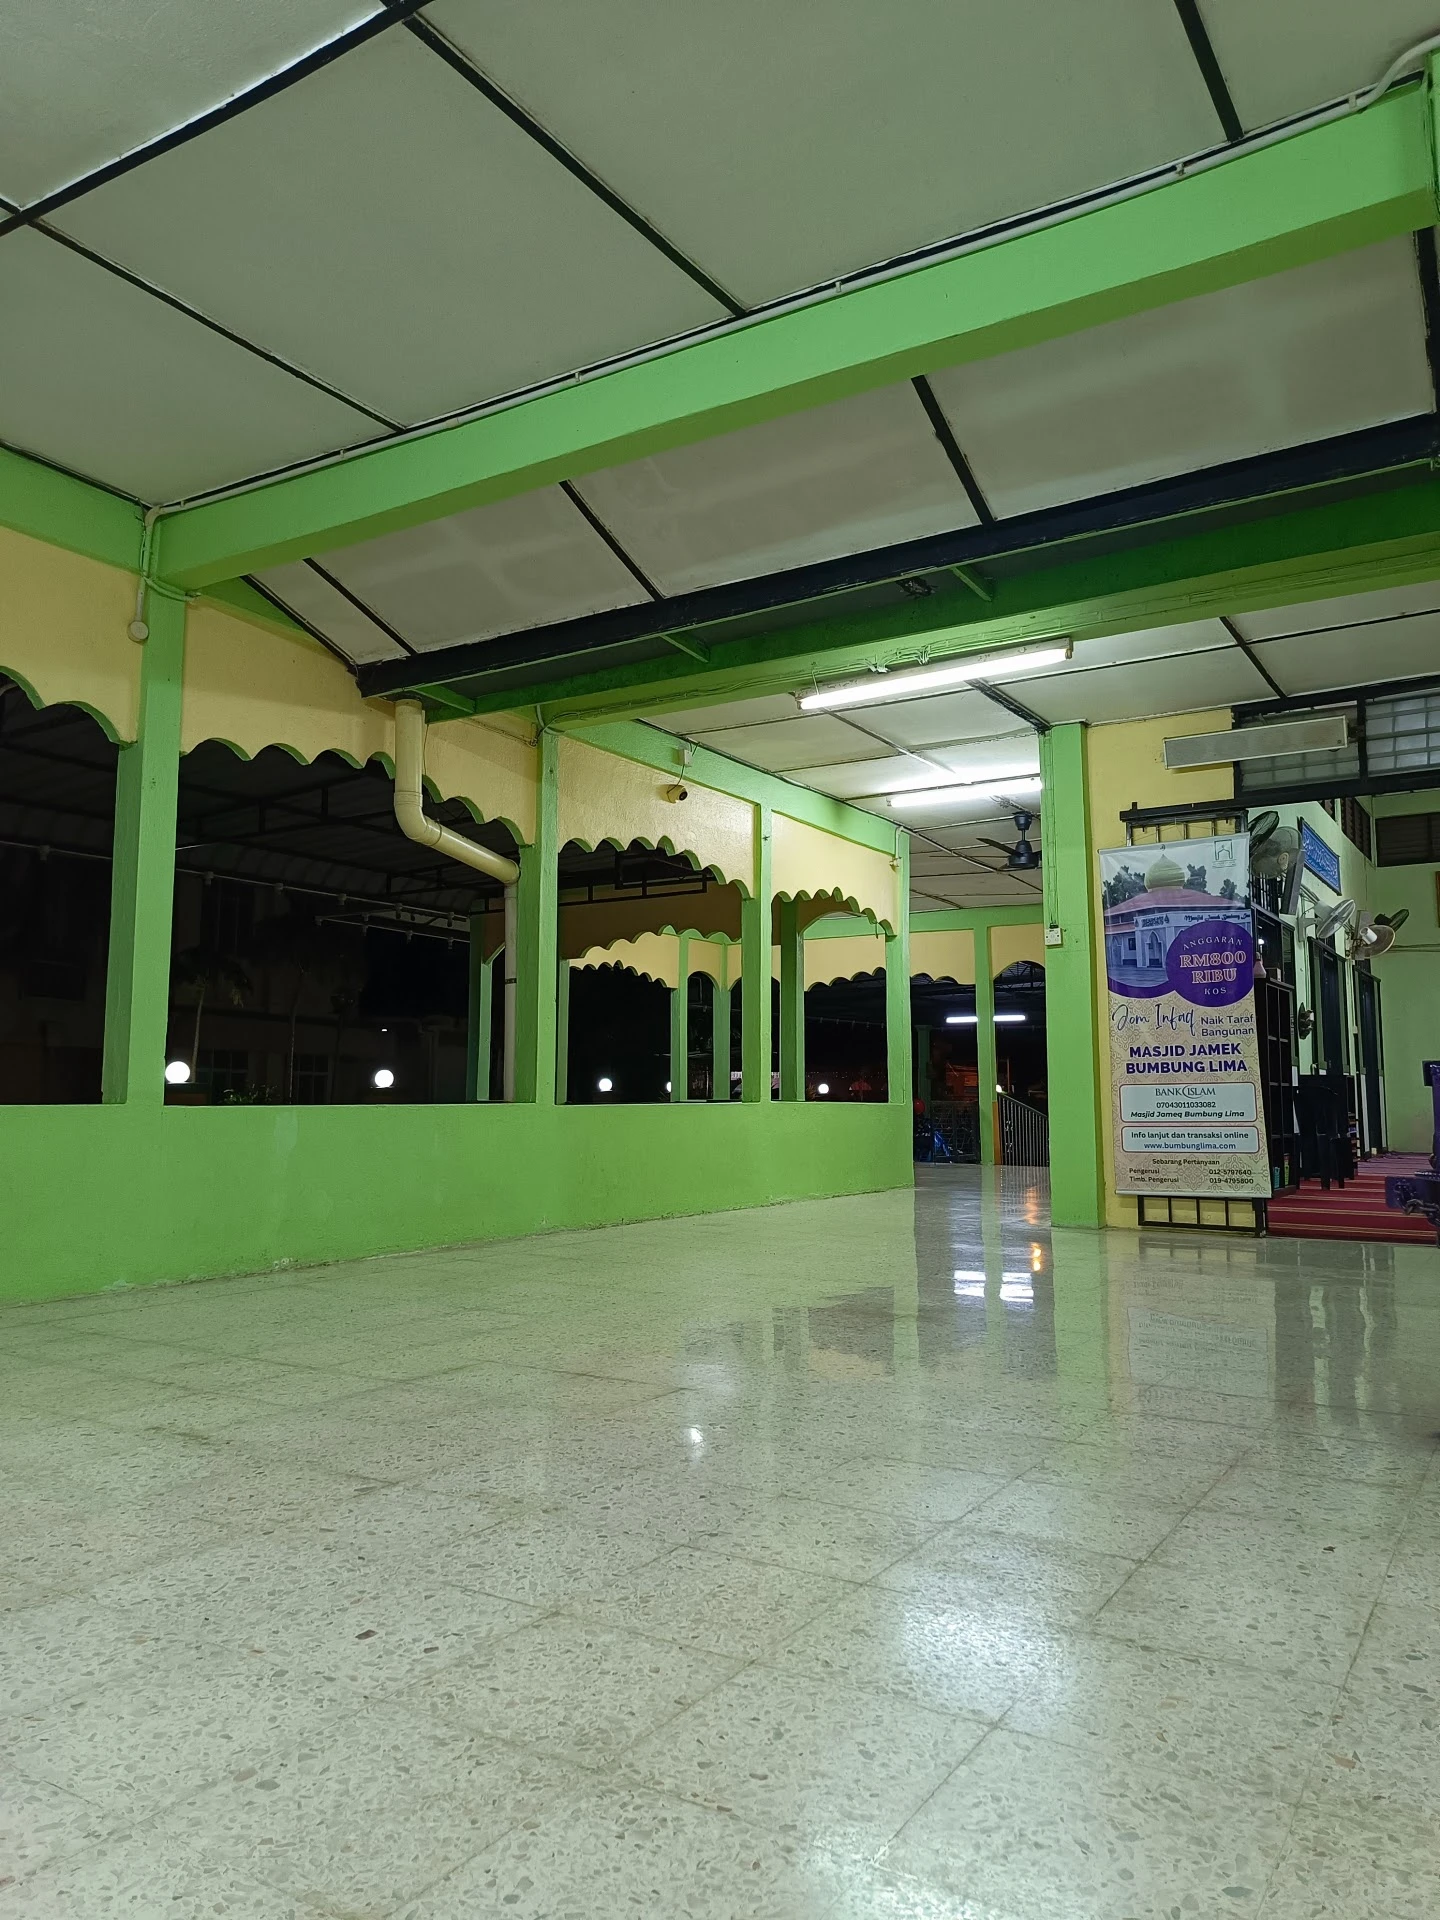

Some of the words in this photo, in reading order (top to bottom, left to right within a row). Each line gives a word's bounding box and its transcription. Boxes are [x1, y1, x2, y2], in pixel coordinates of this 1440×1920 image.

[1183, 936, 1243, 950] ANGGARAN
[1179, 951, 1247, 968] RM800
[1192, 968, 1237, 984] RIBU
[1204, 987, 1227, 996] KOS
[1112, 1003, 1150, 1031] Jom
[1155, 1003, 1196, 1036] Infaq
[1200, 1016, 1224, 1025] Naik
[1227, 1014, 1254, 1024] Taraf
[1201, 1026, 1254, 1038] Bangunan
[1130, 1045, 1186, 1058] MASJID
[1189, 1042, 1242, 1056] JAMEK
[1126, 1061, 1206, 1074] BUMBUNG
[1209, 1060, 1248, 1072] LIMA
[1155, 1087, 1182, 1096] BANK
[1185, 1086, 1216, 1097] ISLAM
[1130, 1110, 1155, 1119] Masjid
[1156, 1111, 1183, 1119] Jameq
[1184, 1110, 1223, 1119] Bumbung
[1148, 1131, 1170, 1140] lanjut
[1171, 1131, 1186, 1139] dan
[1187, 1131, 1222, 1139] transaksi
[1224, 1131, 1249, 1139] online
[1144, 1142, 1236, 1150] www.bumbunglima.com
